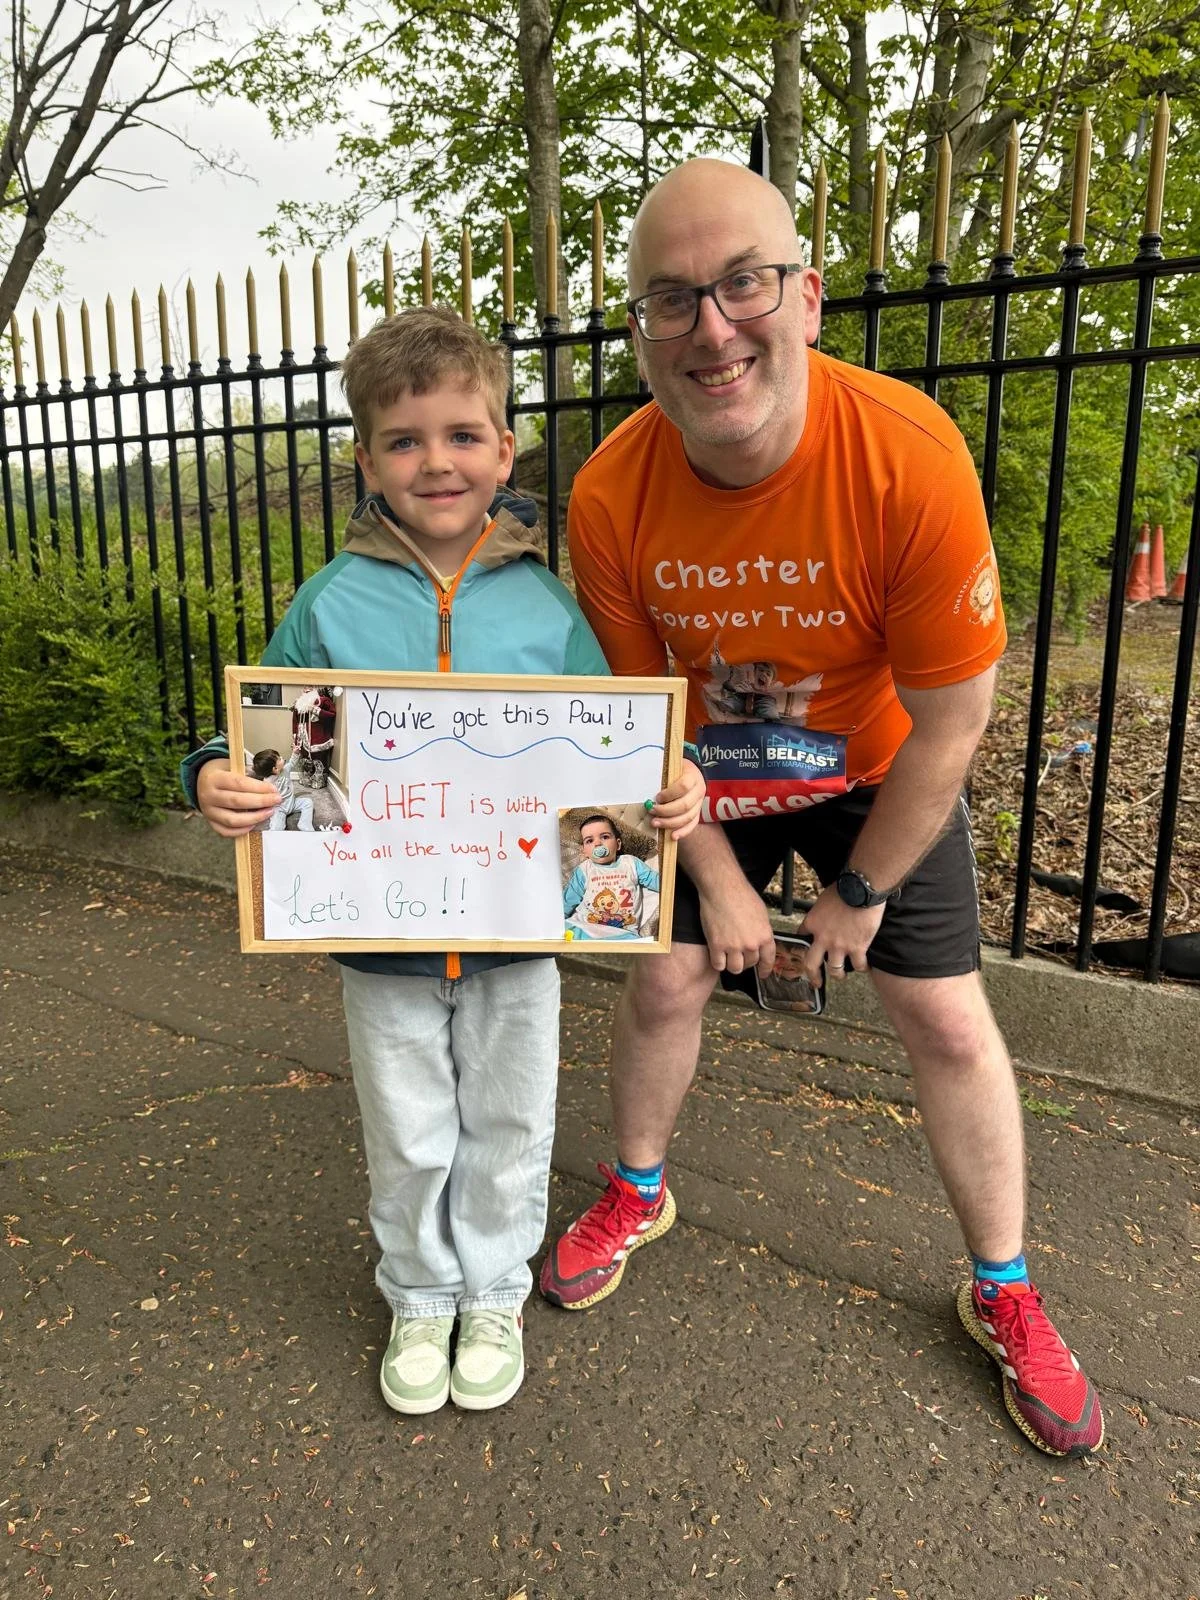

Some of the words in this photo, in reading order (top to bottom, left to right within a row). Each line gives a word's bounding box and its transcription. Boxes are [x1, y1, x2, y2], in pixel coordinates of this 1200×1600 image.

[654, 555, 825, 590] Chester
[774, 605, 847, 629] Two
[361, 691, 435, 735] You've
[453, 707, 488, 738] got
[502, 703, 549, 726] this
[709, 744, 760, 760] Phoenix
[738, 760, 760, 769] Energy
[766, 747, 838, 767] BELFAST
[766, 760, 781, 768] CITY
[782, 760, 820, 772] MARATHON
[361, 779, 451, 821] CHET
[470, 792, 495, 815] is
[506, 795, 548, 815] with
[323, 840, 357, 866] You
[371, 844, 392, 860] all
[404, 841, 441, 857] the
[283, 874, 361, 926] Let's
